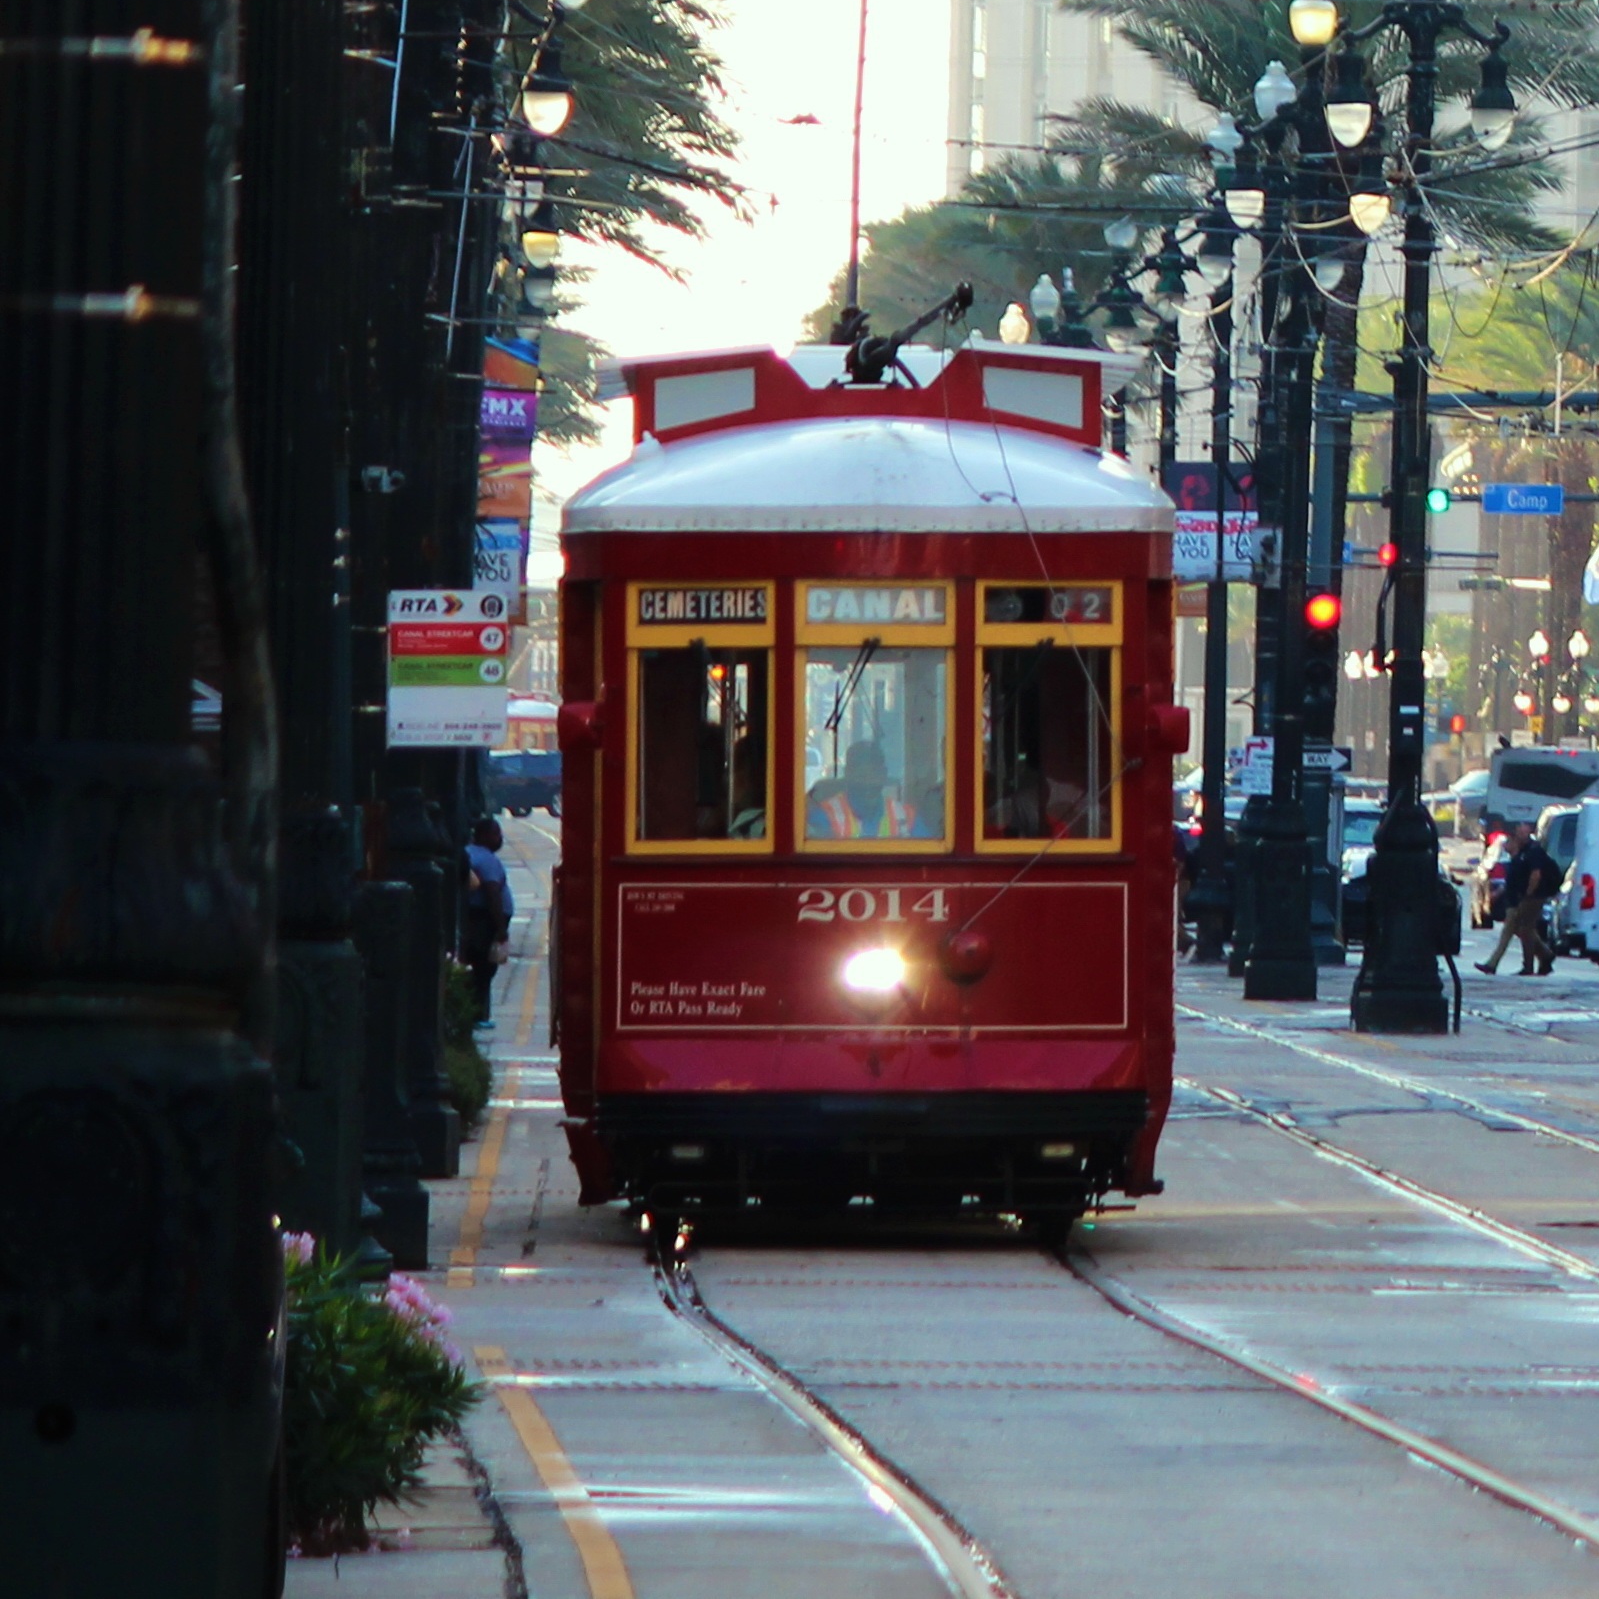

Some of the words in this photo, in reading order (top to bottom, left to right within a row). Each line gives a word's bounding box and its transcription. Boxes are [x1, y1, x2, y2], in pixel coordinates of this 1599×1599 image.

[1507, 488, 1549, 511] Camp
[1180, 546, 1210, 559] YOU
[400, 598, 438, 613] RTA
[640, 588, 767, 621] CEMETERIES
[807, 588, 945, 620] CANAL
[485, 633, 499, 643] 47
[797, 888, 950, 923] 2014
[631, 981, 665, 996] Please
[669, 981, 698, 996] Have
[702, 982, 735, 996] Exact
[740, 982, 766, 996] Fare
[630, 1001, 645, 1014] Or
[649, 1001, 673, 1015] RTA
[678, 1002, 703, 1015] Pass
[707, 1002, 743, 1018] Ready
